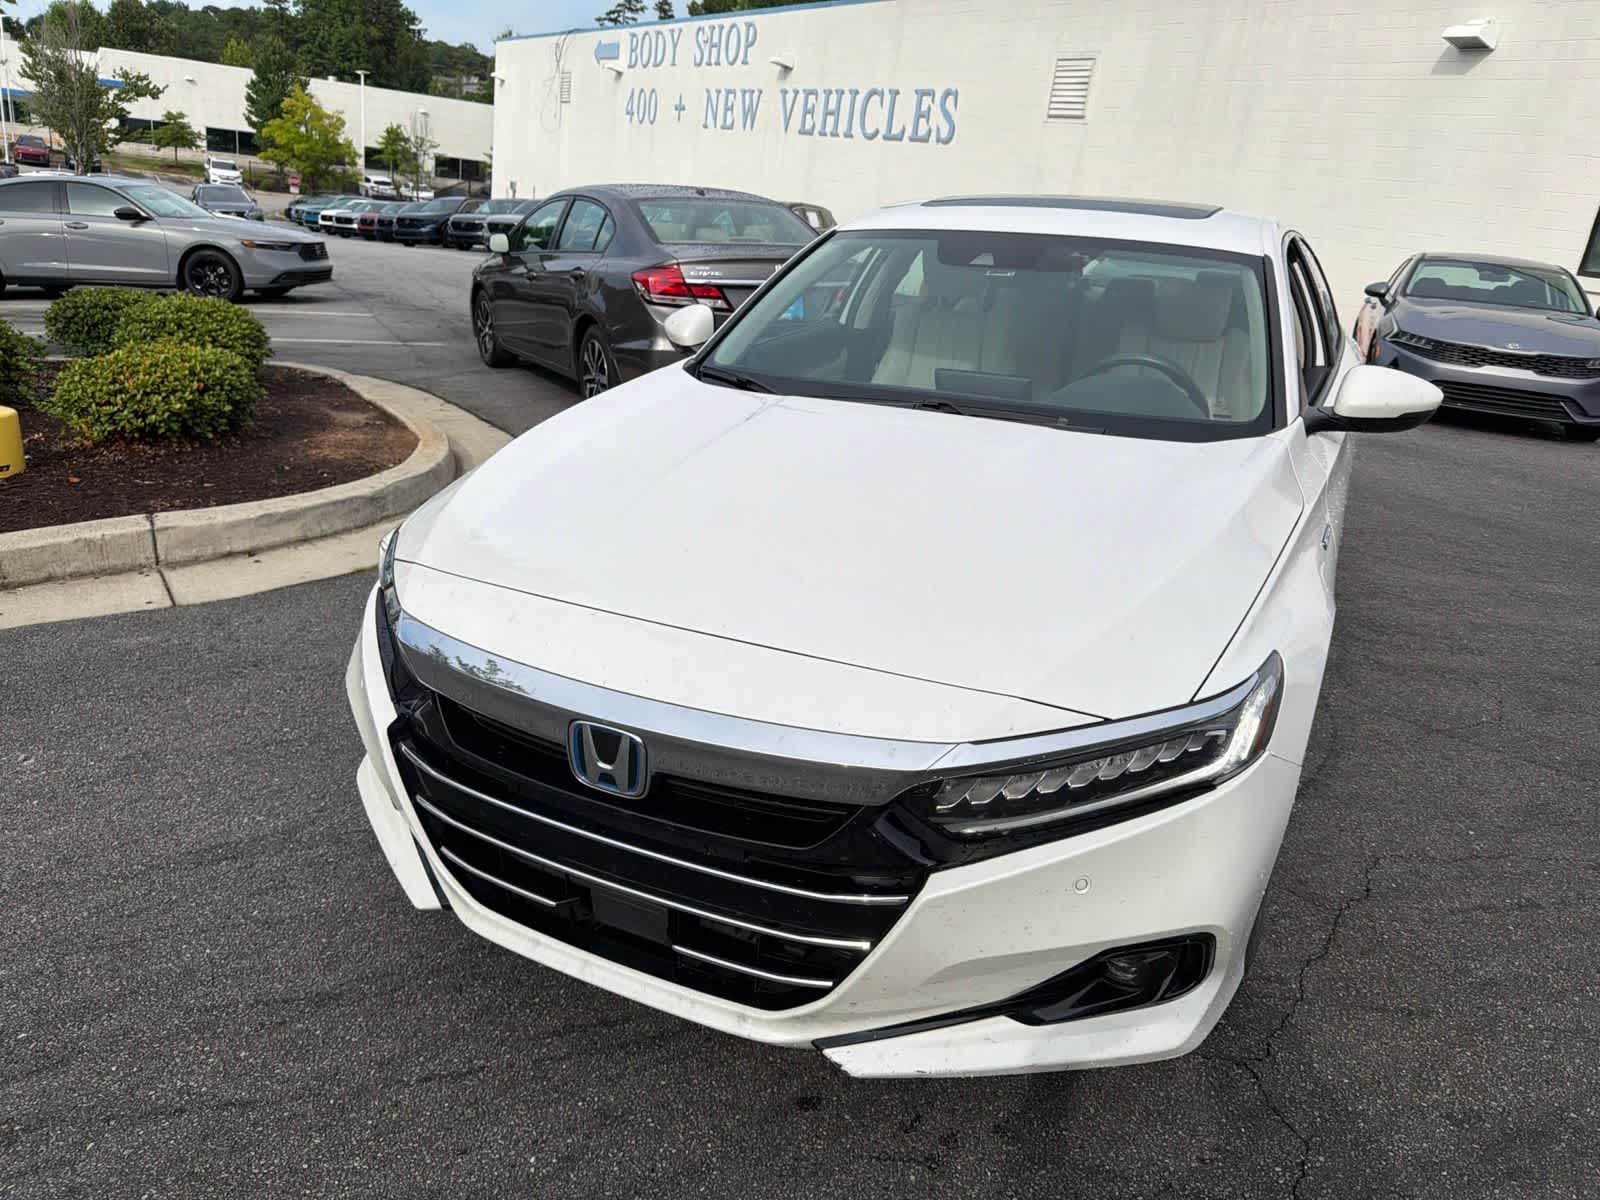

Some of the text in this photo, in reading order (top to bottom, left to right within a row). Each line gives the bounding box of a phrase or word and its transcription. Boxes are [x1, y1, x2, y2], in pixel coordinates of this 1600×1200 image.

[627, 21, 758, 69] BODY SHOP
[625, 87, 959, 145] 400 + NEW VEHICLES
